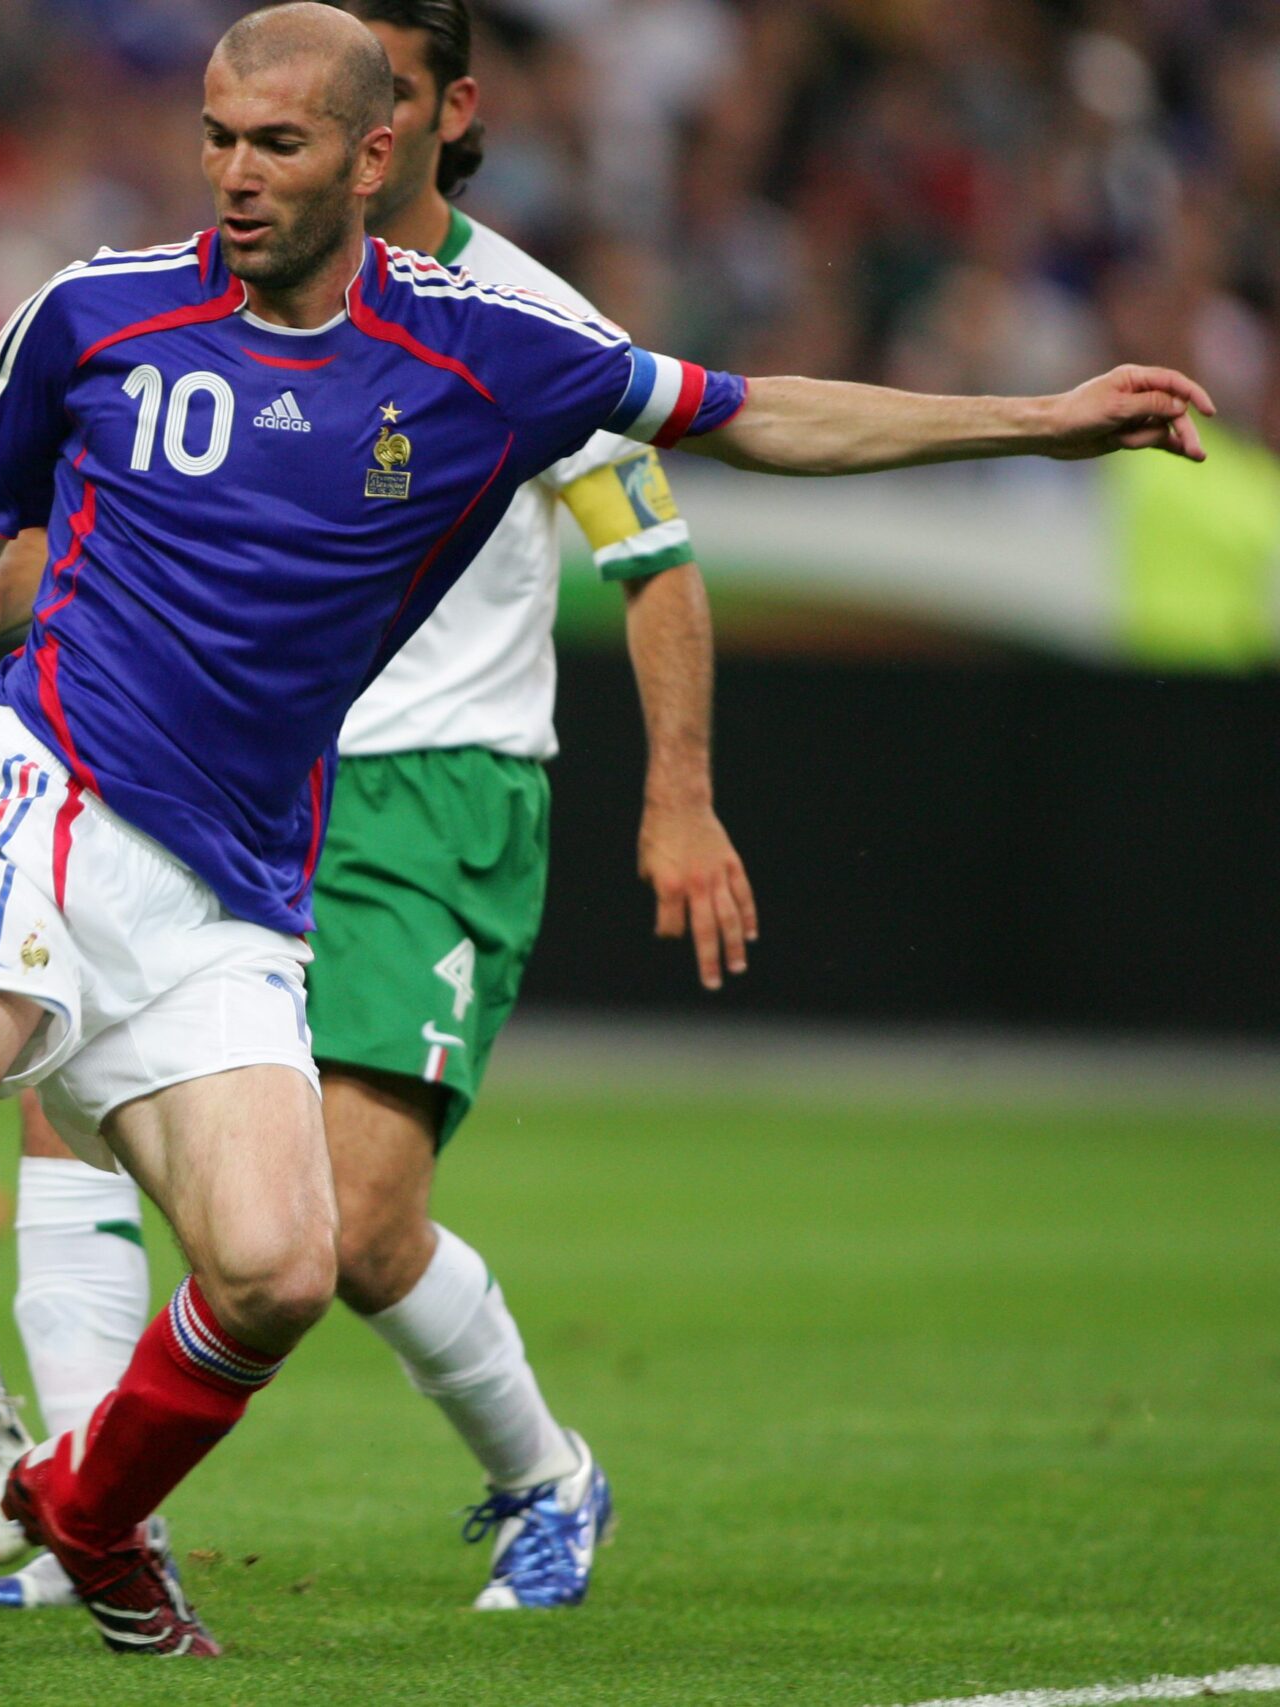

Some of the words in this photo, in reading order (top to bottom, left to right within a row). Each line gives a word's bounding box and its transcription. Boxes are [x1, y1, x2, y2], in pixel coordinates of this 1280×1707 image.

[121, 364, 235, 477] 10
[253, 416, 311, 432] adidas
[433, 937, 475, 1021] 4
